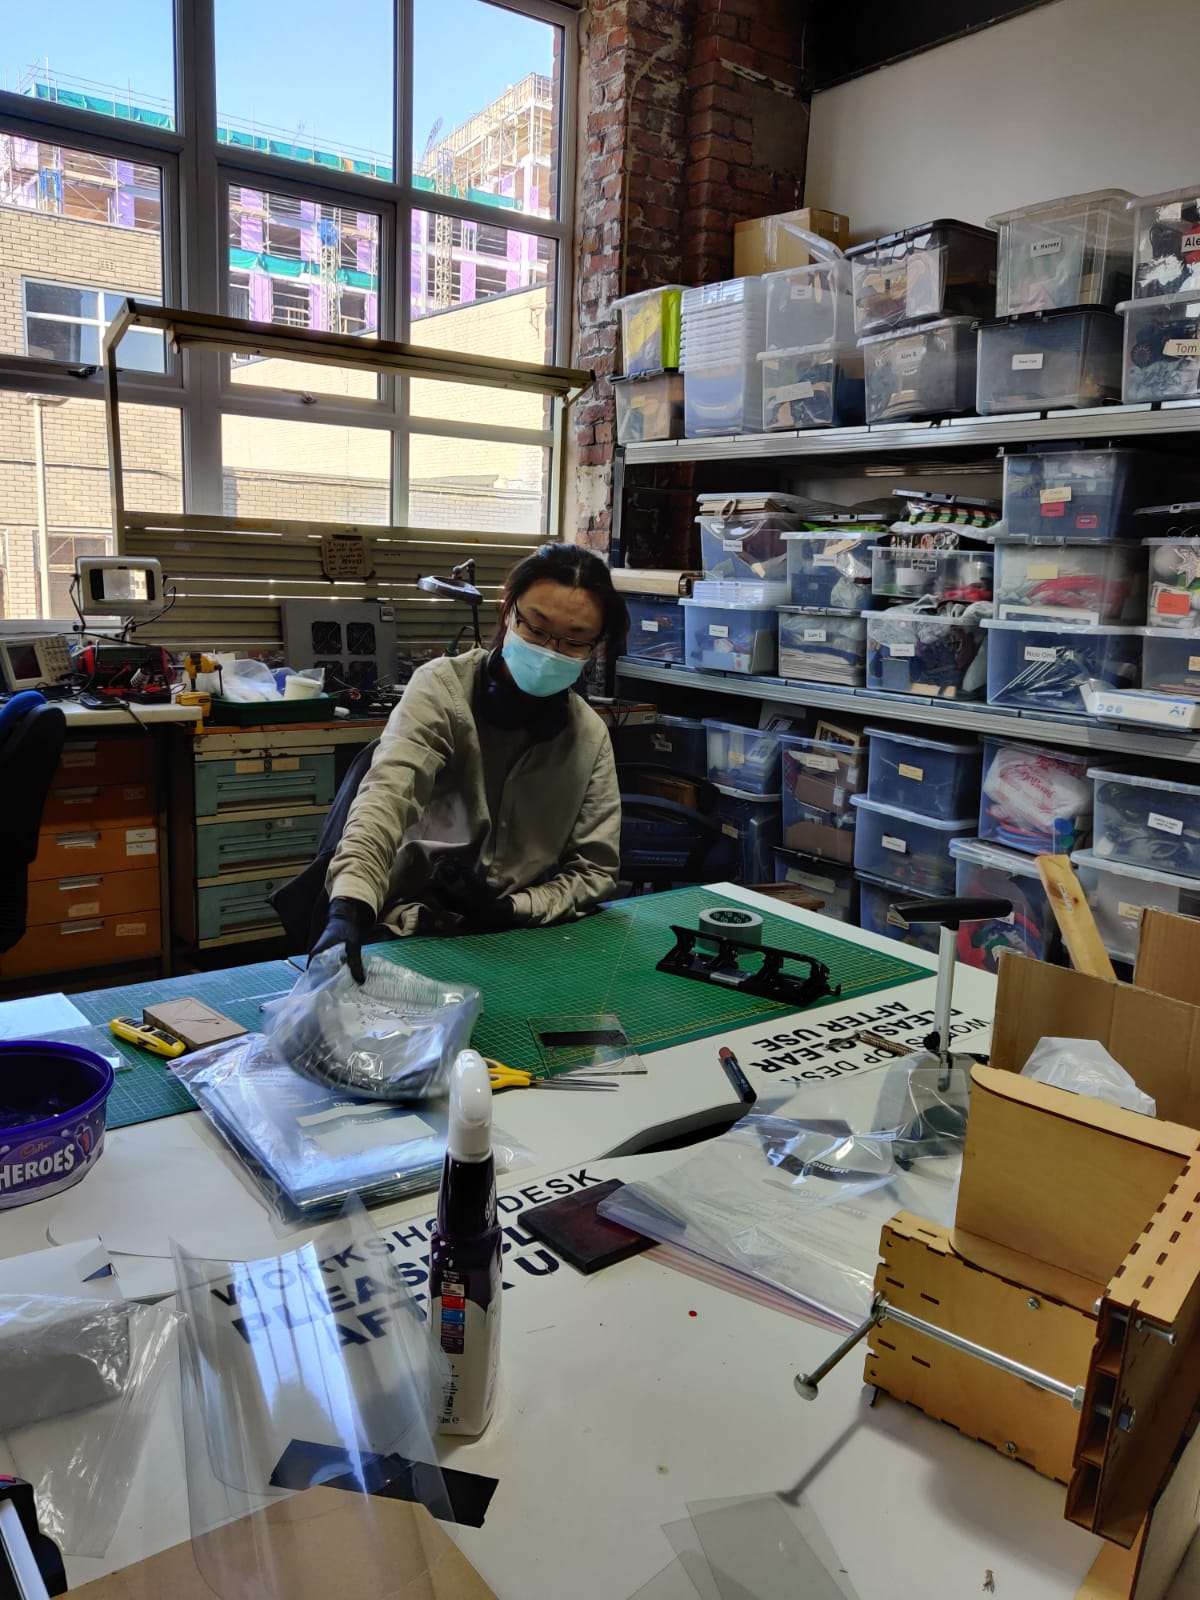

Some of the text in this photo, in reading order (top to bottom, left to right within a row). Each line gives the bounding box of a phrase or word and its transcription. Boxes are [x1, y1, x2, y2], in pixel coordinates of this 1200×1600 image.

[1175, 342, 1198, 354] Tom
[751, 1001, 910, 1052] AFTER USE
[0, 1143, 75, 1191] HEROES
[210, 1218, 438, 1306] WORKSH
[496, 1168, 603, 1213] DESK
[231, 1254, 430, 1345] PLEAS
